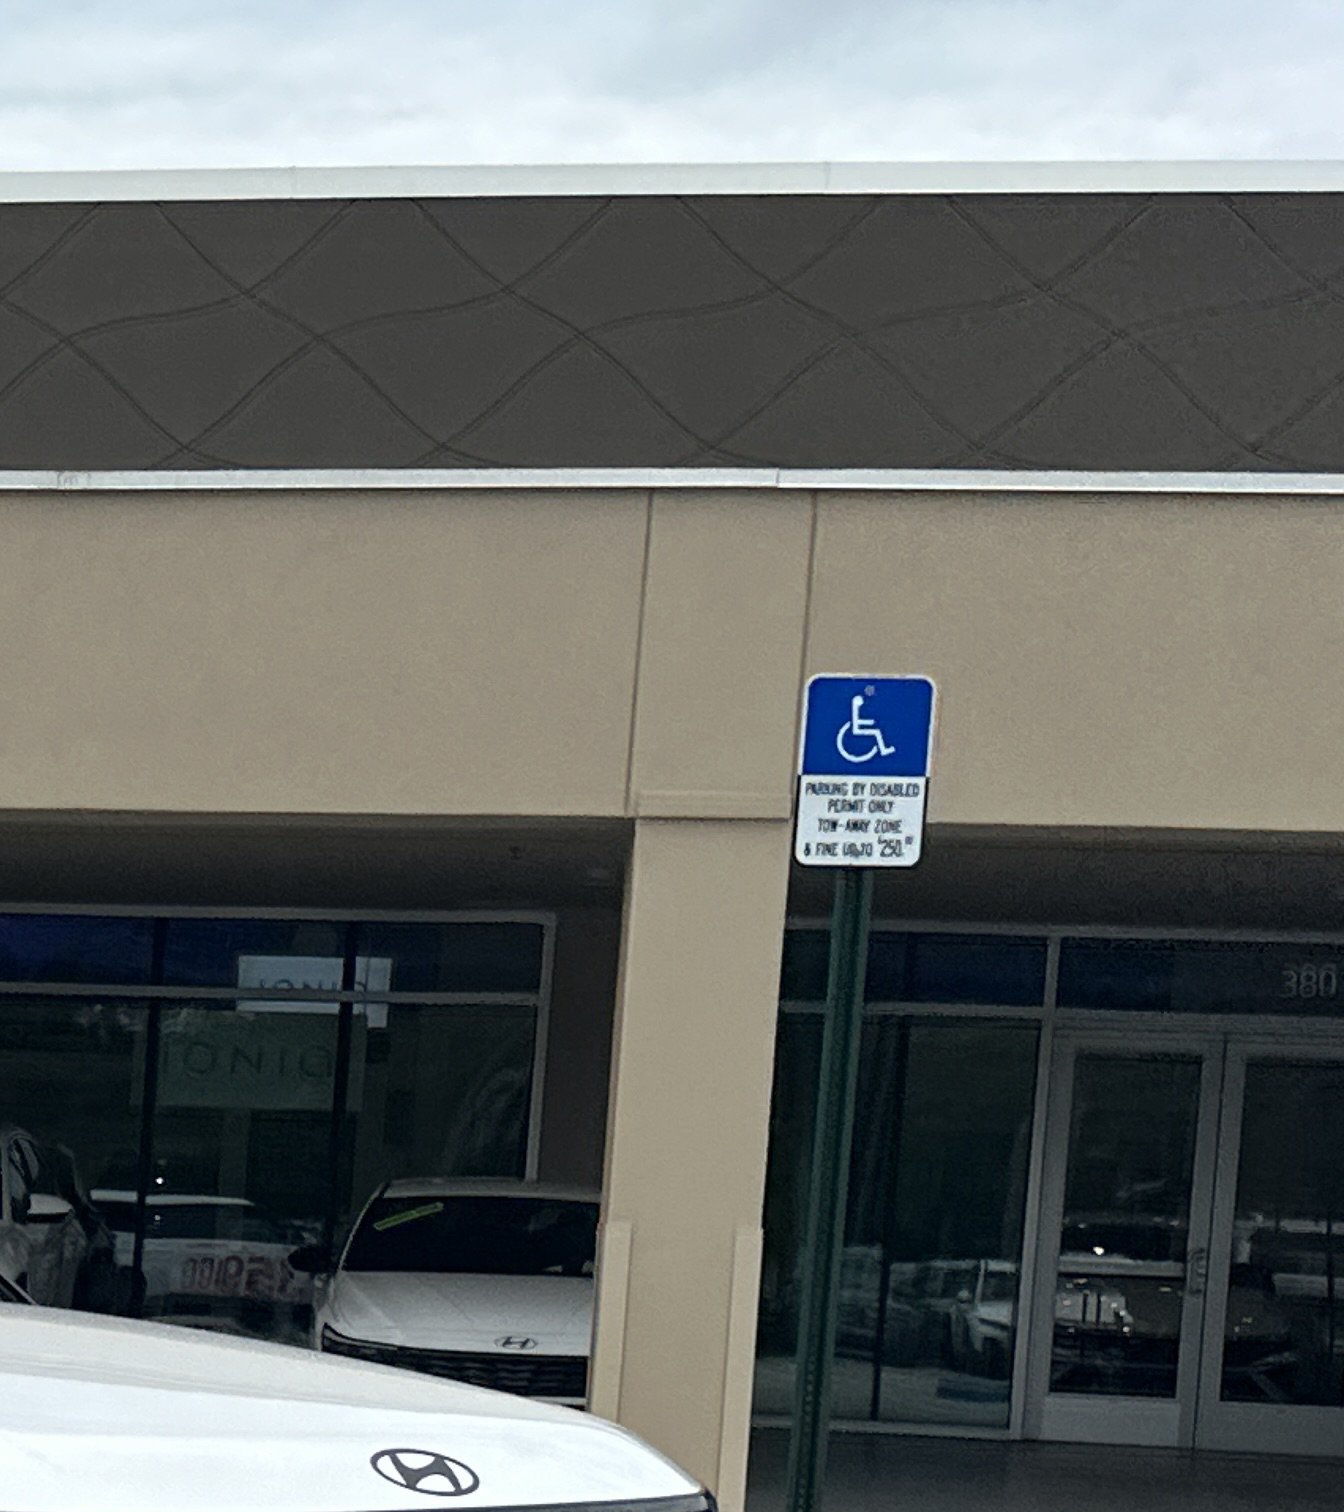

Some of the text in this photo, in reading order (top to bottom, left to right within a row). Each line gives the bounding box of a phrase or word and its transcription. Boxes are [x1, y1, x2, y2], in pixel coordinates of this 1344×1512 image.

[852, 783, 866, 796] BY
[869, 783, 920, 797] DISABLED
[827, 799, 894, 814] PERMIT ONLY
[874, 819, 903, 833] ZONE
